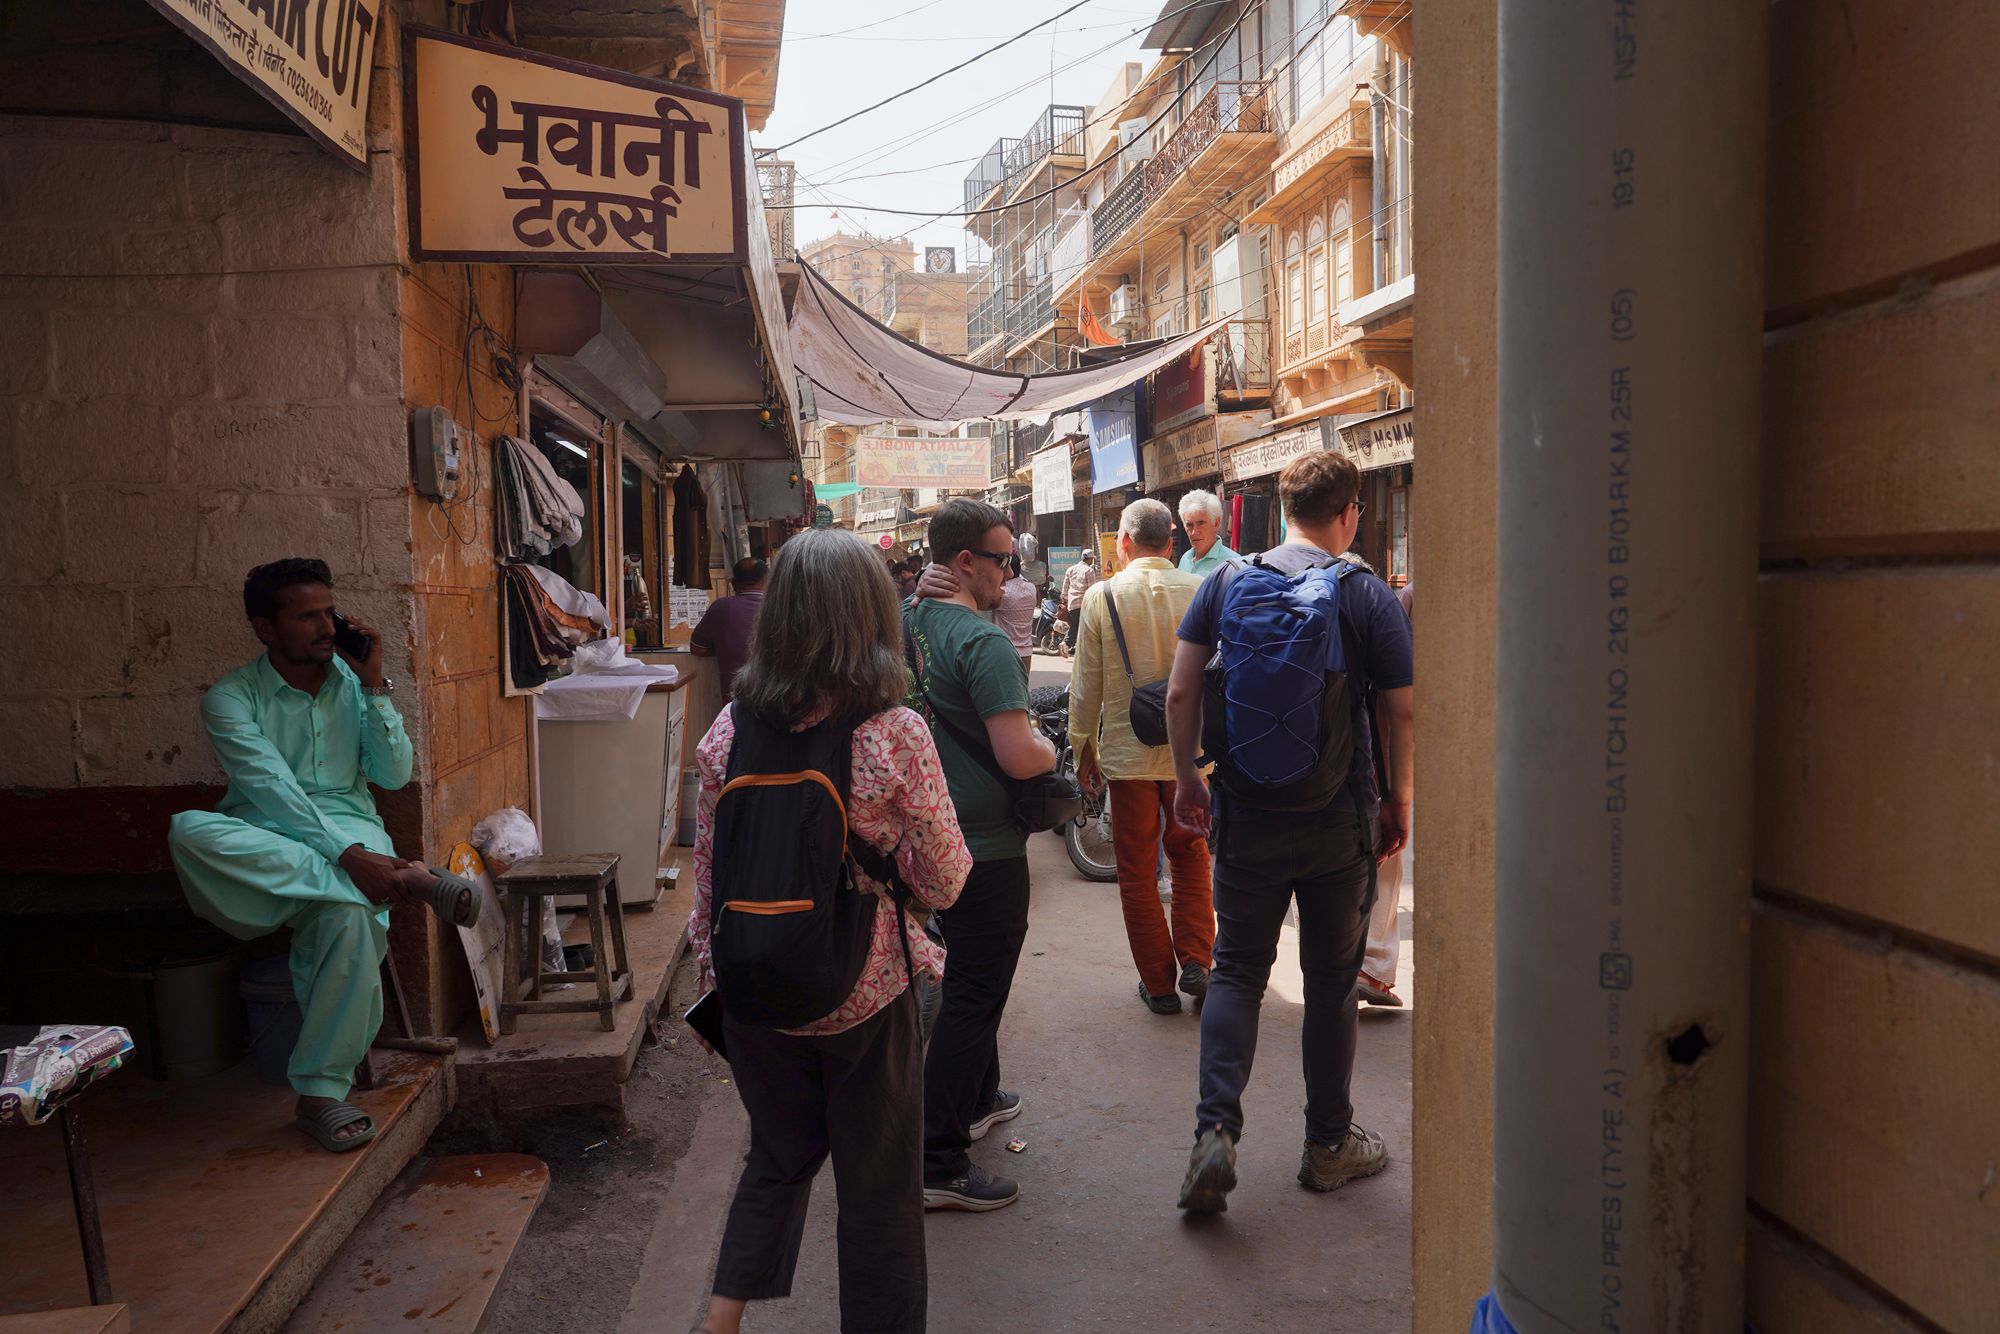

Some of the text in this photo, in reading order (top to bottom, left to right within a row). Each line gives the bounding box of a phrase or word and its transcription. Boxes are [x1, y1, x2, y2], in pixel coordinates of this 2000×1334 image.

[286, 67, 333, 123] 7023620366
[471, 84, 713, 189] भवानी
[502, 166, 682, 253] टेलर्स
[1610, 288, 1637, 343] (05)
[1095, 415, 1132, 453] SAMSUNG
[1605, 717, 1628, 813] BATCH
[87, 1035, 121, 1058] PhonePe
[1602, 1196, 1622, 1268] PIPES
